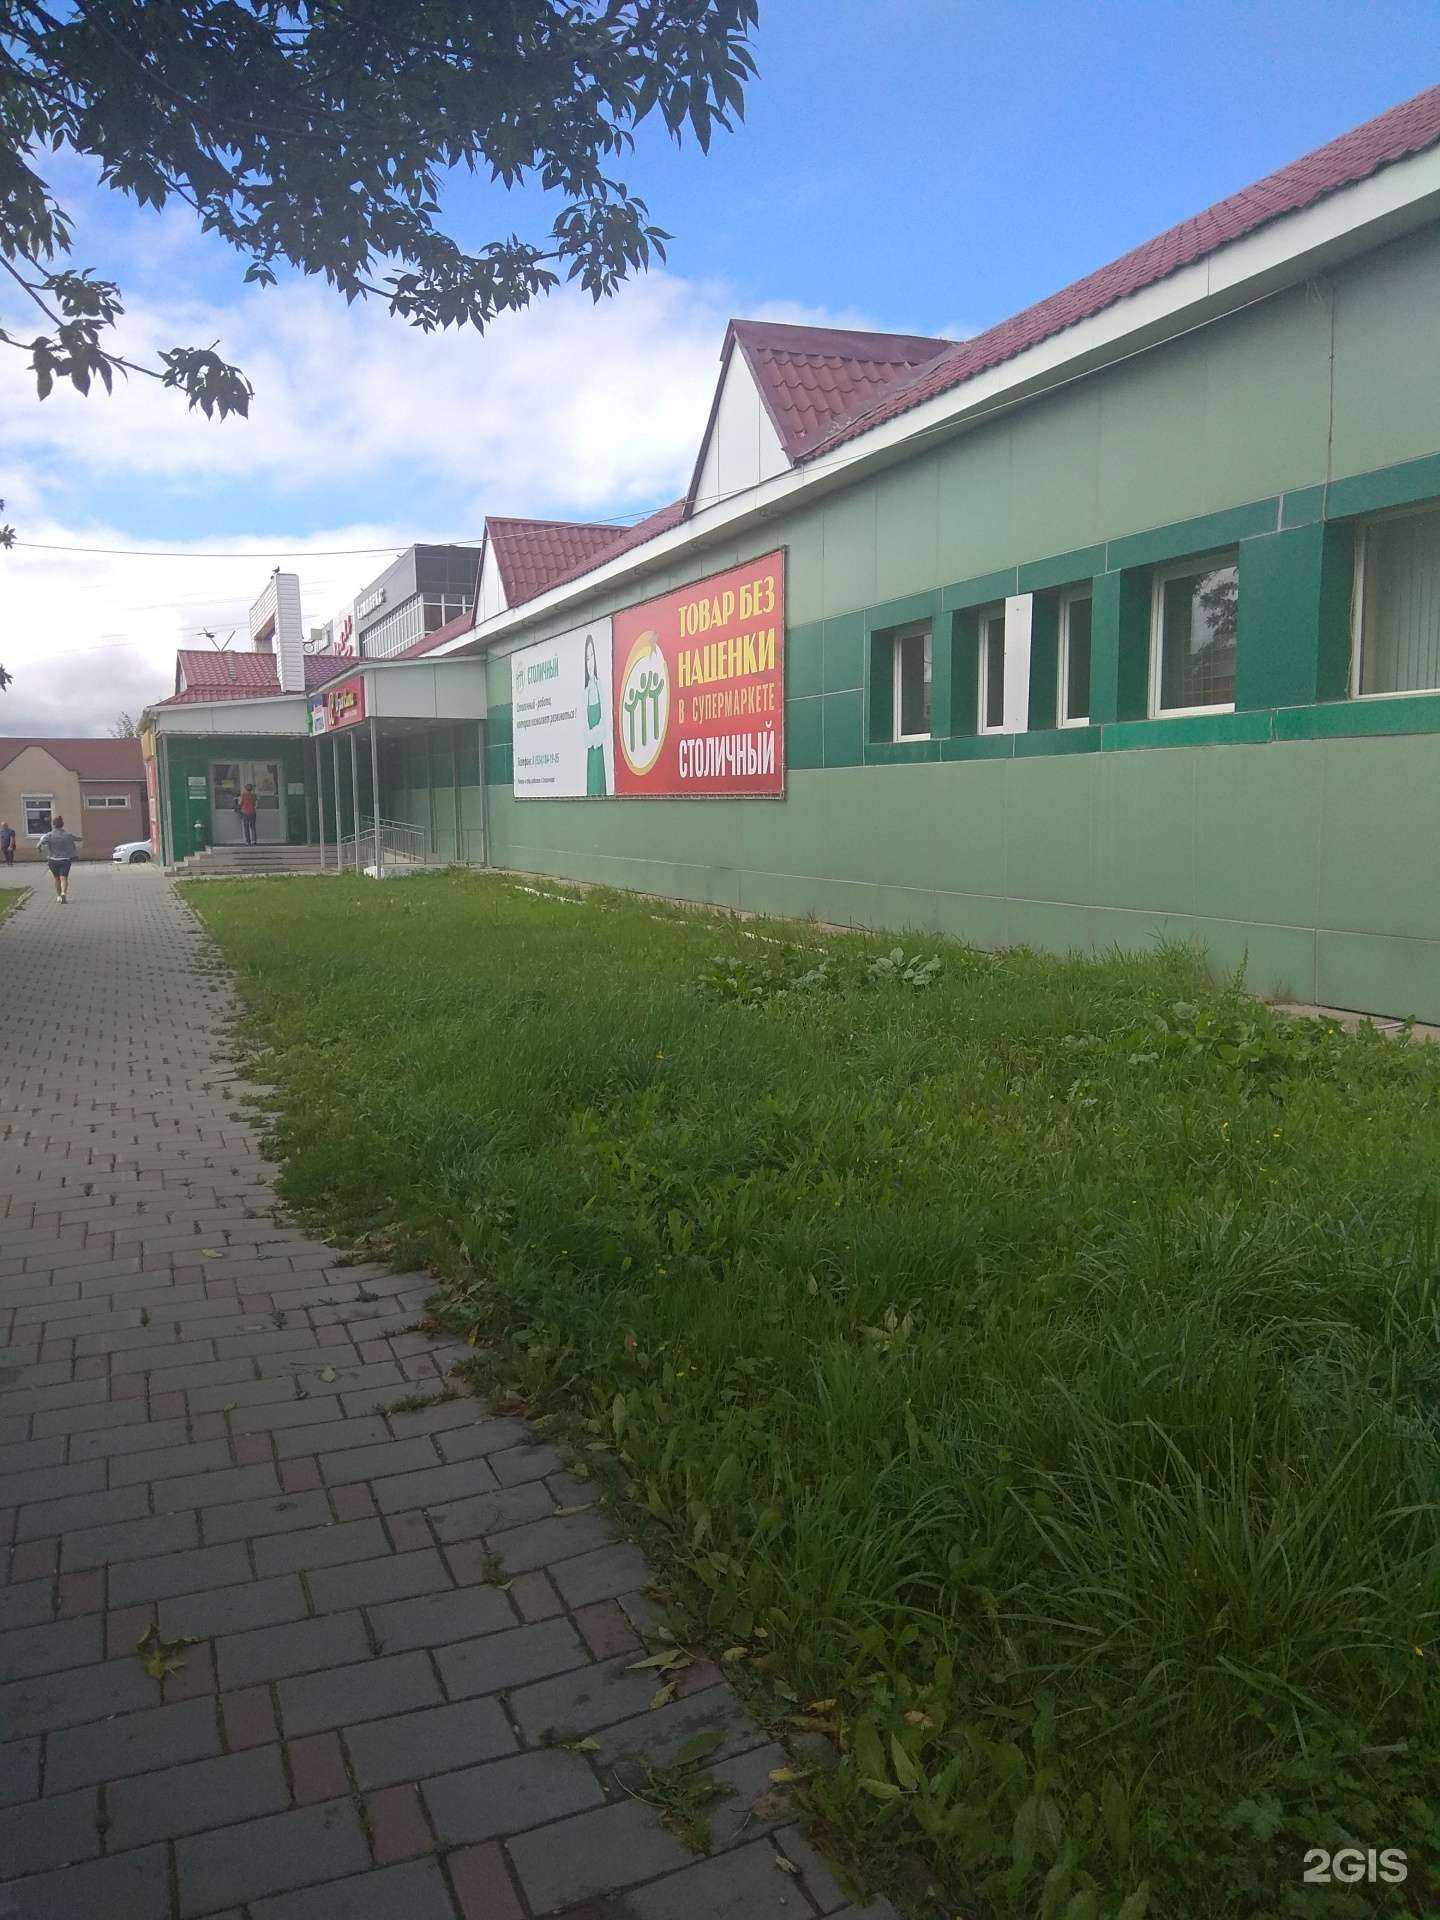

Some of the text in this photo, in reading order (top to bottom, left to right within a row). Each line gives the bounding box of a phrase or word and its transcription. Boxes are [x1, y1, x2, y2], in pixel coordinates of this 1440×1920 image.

[678, 575, 775, 638] ТОВАР БЕЗ
[678, 627, 775, 688] НАЦЕНКИ
[678, 682, 775, 725] В СУПЕРМАРКЕТЕ
[679, 719, 775, 778] СТОЛИЧНЫЙ
